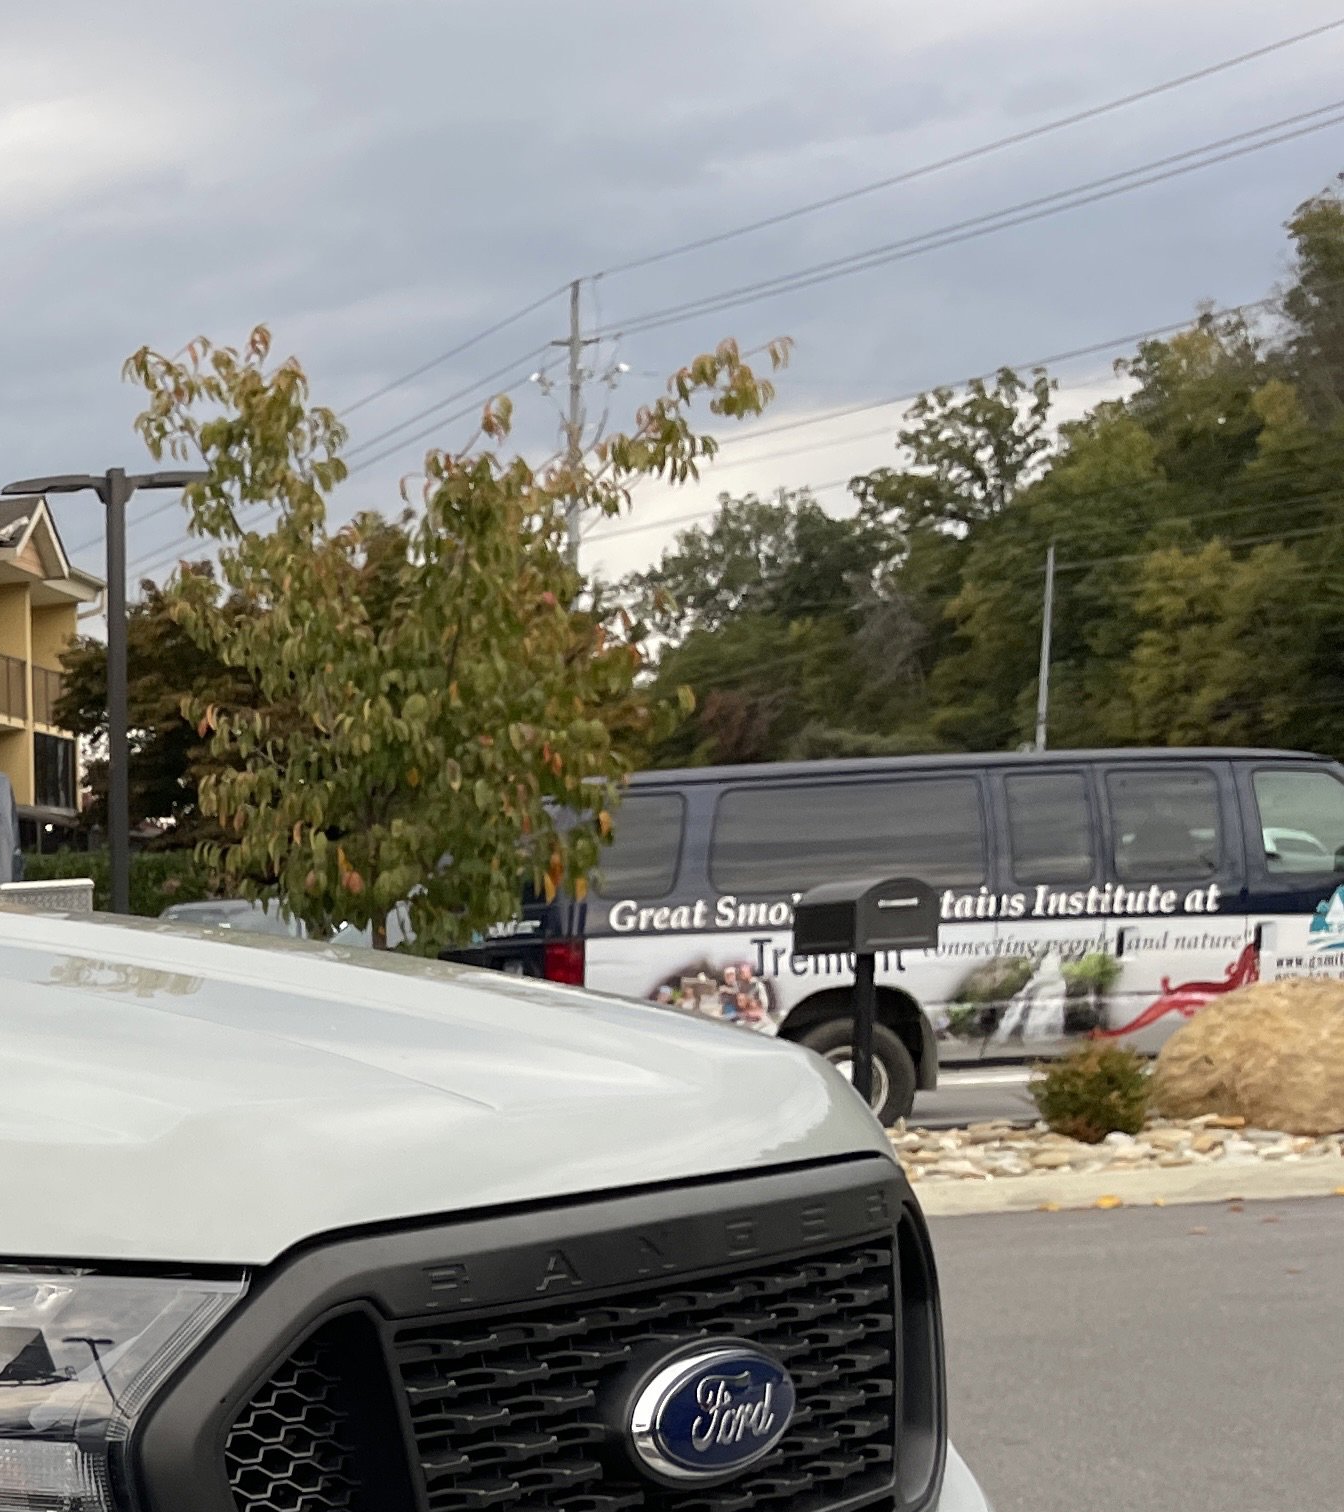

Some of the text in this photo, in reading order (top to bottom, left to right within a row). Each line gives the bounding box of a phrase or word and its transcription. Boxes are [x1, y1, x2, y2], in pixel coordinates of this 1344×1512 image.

[610, 883, 1222, 932] Great Smo tains Institute at
[691, 1370, 775, 1452] Ford
